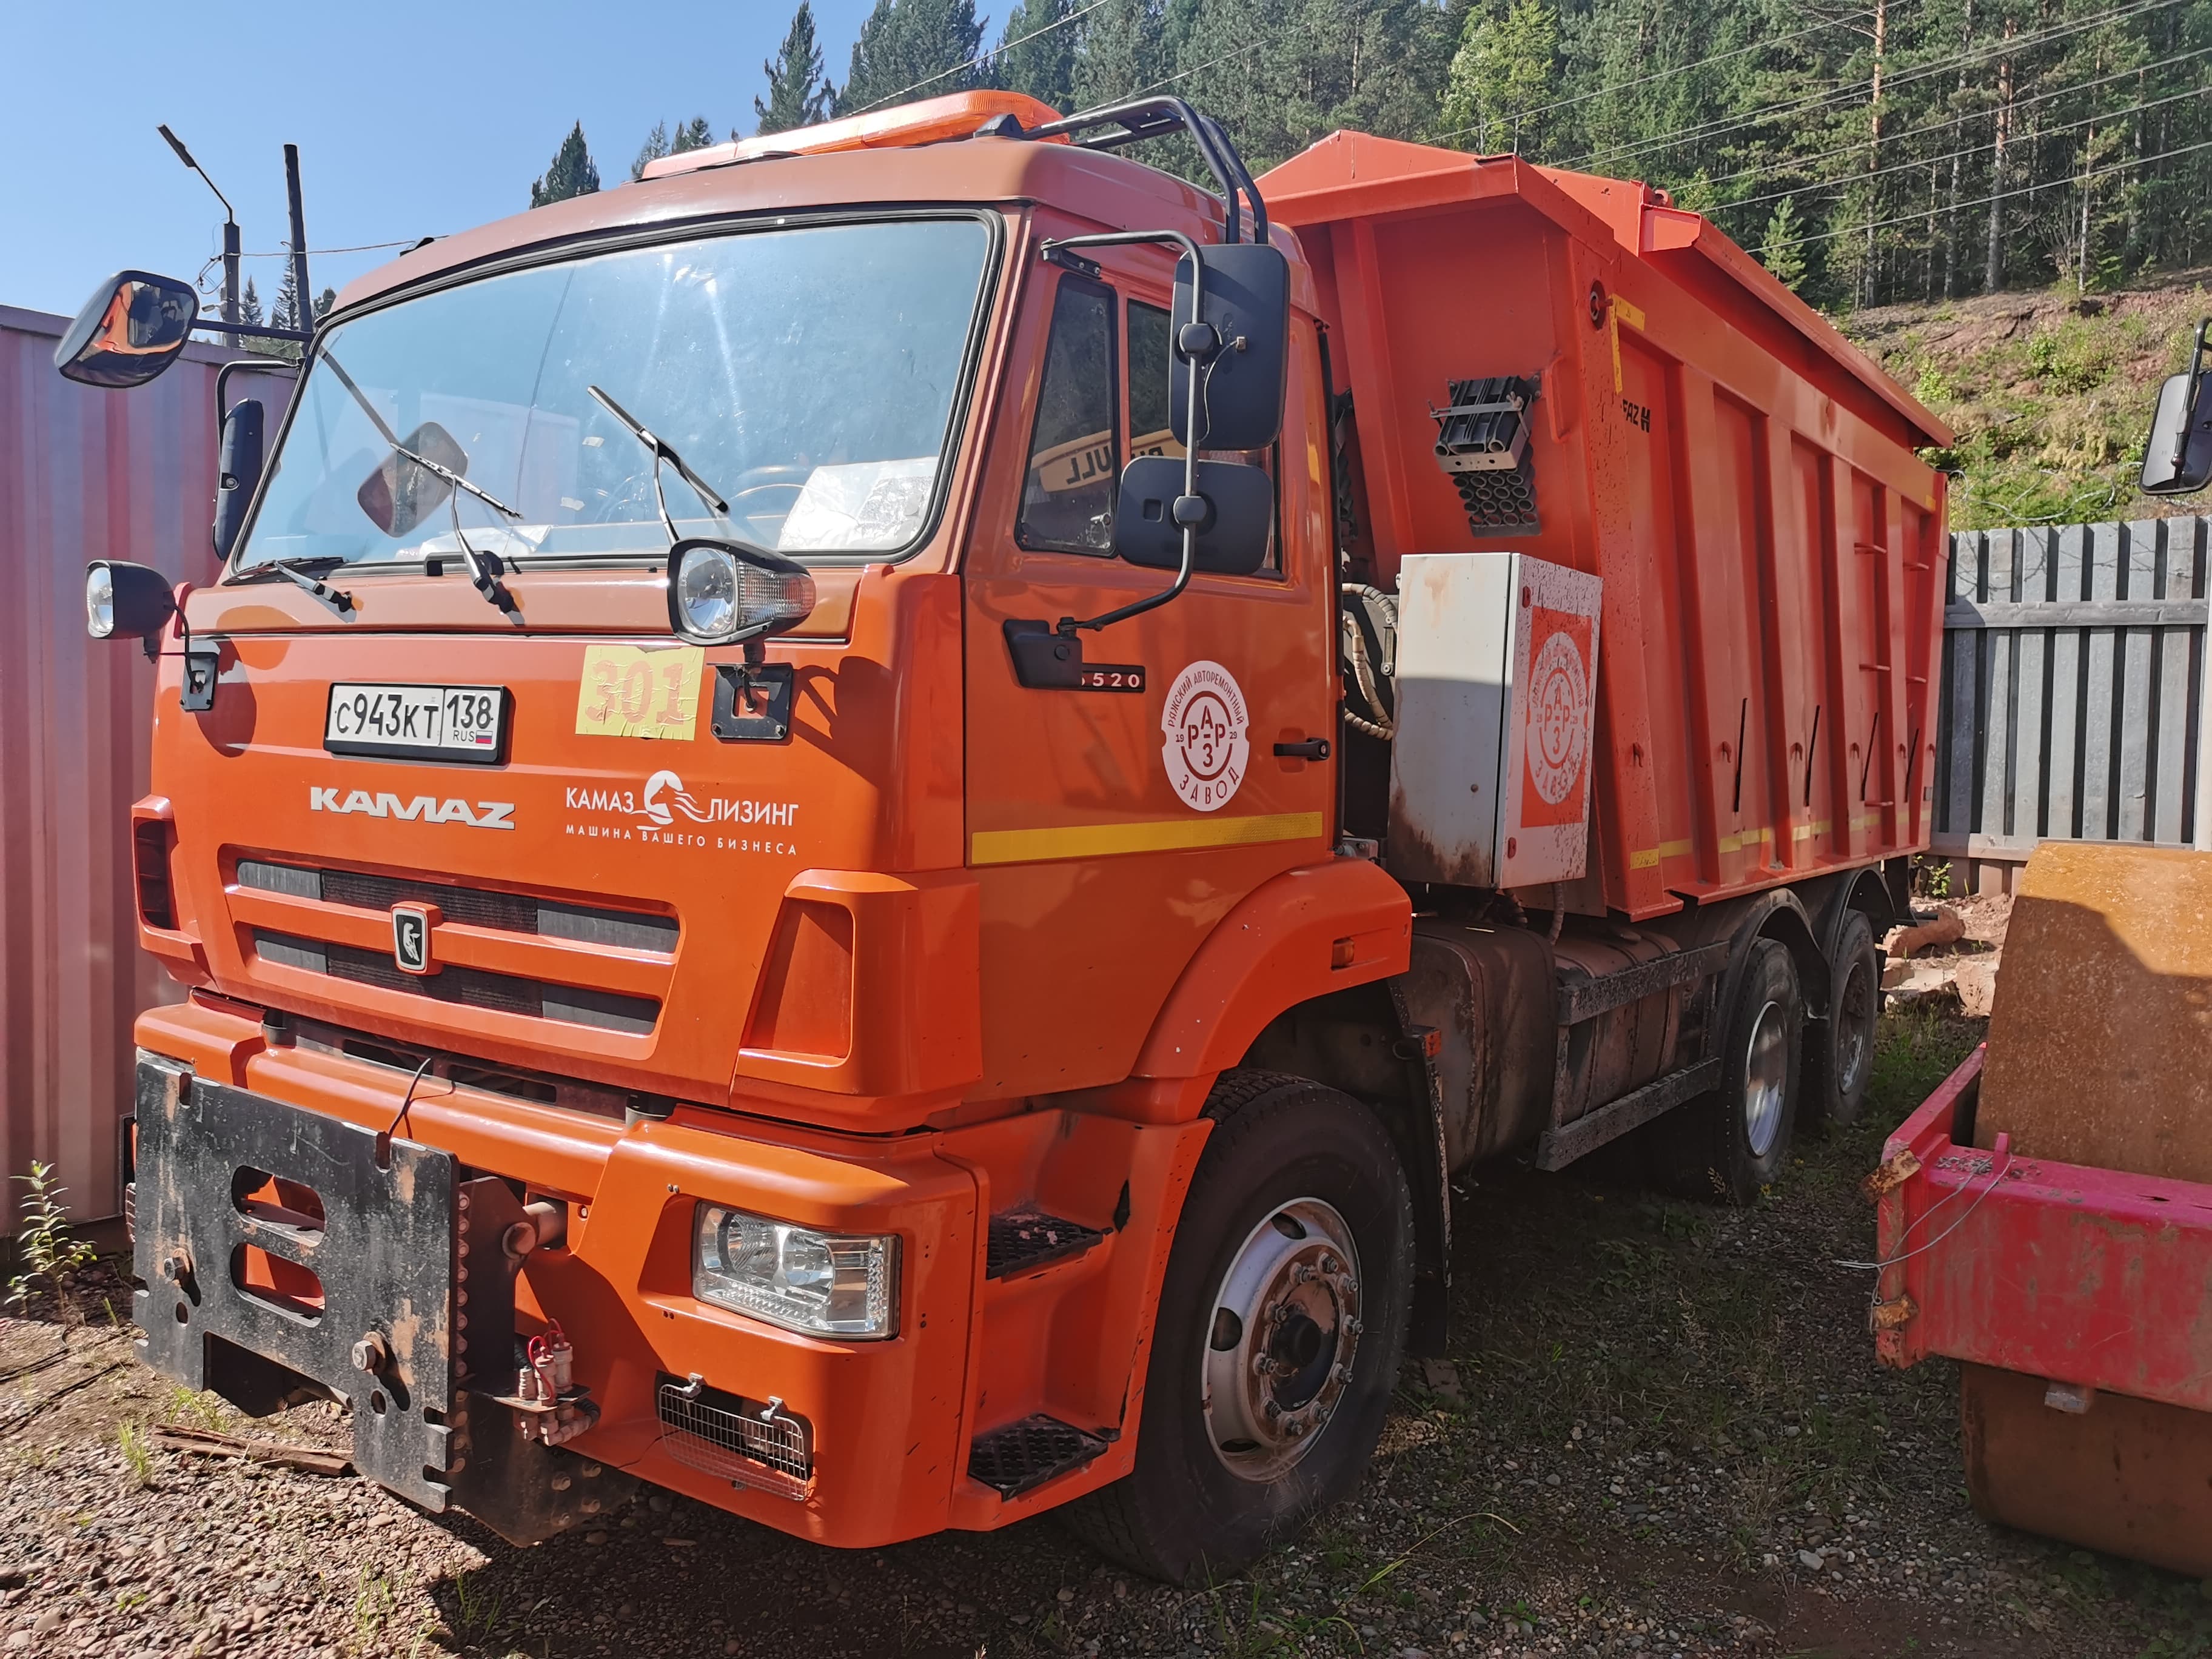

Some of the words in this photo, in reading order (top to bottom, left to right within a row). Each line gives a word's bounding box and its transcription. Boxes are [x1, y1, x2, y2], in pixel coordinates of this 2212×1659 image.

[585, 659, 684, 725] 301
[1081, 672, 1140, 688] 520
[1167, 676, 1193, 728] РЯЖСКИЙ
[1193, 669, 1245, 725] АВТОРЕМОНТНЫЙ
[337, 691, 440, 740] С943КТ
[446, 692, 492, 729] 138
[453, 729, 475, 743] RUS
[1175, 733, 1185, 743] 19
[1228, 731, 1238, 740] 29
[1179, 766, 1240, 805] ЗАВОД
[310, 786, 515, 831] KAMAZ
[565, 786, 634, 813] КАМАЗ
[707, 798, 799, 826] ЛИЗИНГ
[565, 823, 632, 840] МАШИНА
[641, 830, 706, 847] ВАШЕГО
[717, 837, 797, 856] БИЗНЕСА
